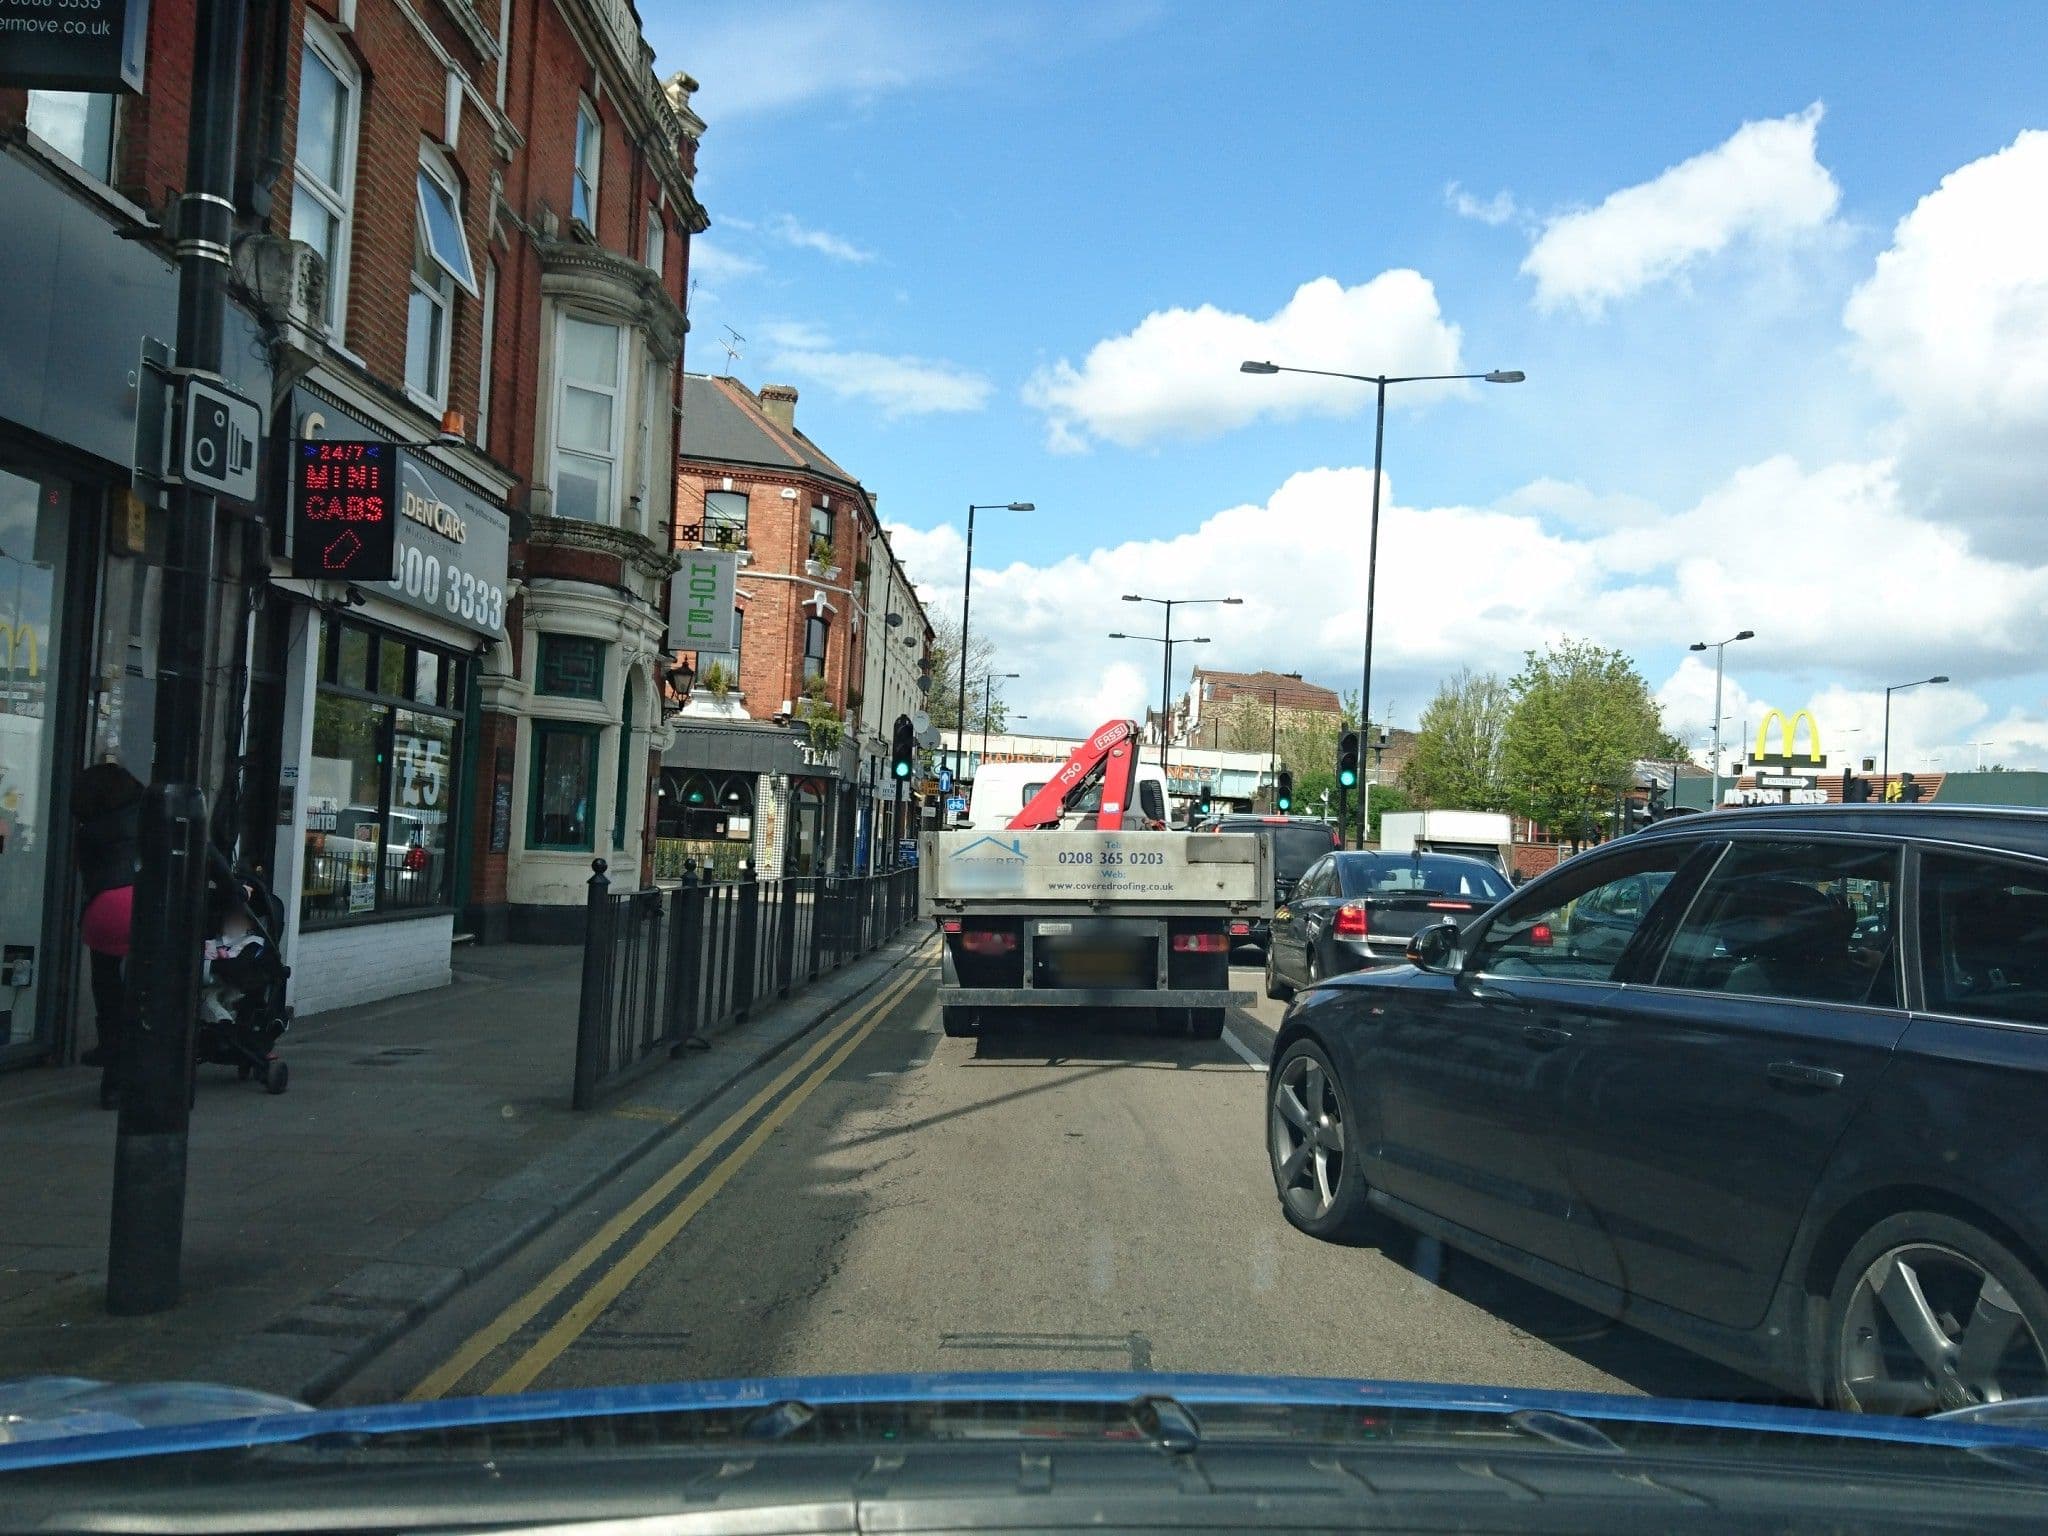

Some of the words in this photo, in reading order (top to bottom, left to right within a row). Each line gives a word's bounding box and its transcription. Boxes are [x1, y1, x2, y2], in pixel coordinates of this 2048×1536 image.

[320, 444, 364, 460] 24/7
[306, 464, 379, 489] MINI
[306, 495, 384, 522] CABS
[446, 565, 502, 631] 3333
[687, 563, 717, 638] HOTEL
[1097, 725, 1126, 749] FASSI
[403, 737, 441, 805] £5
[1060, 762, 1082, 785] F50
[1058, 852, 1093, 865] 0208
[1099, 852, 1123, 865] 365
[1130, 852, 1164, 865] 0203
[1048, 881, 1174, 893] www.coveredroofing.co.uk
[1101, 870, 1126, 880] Web:
